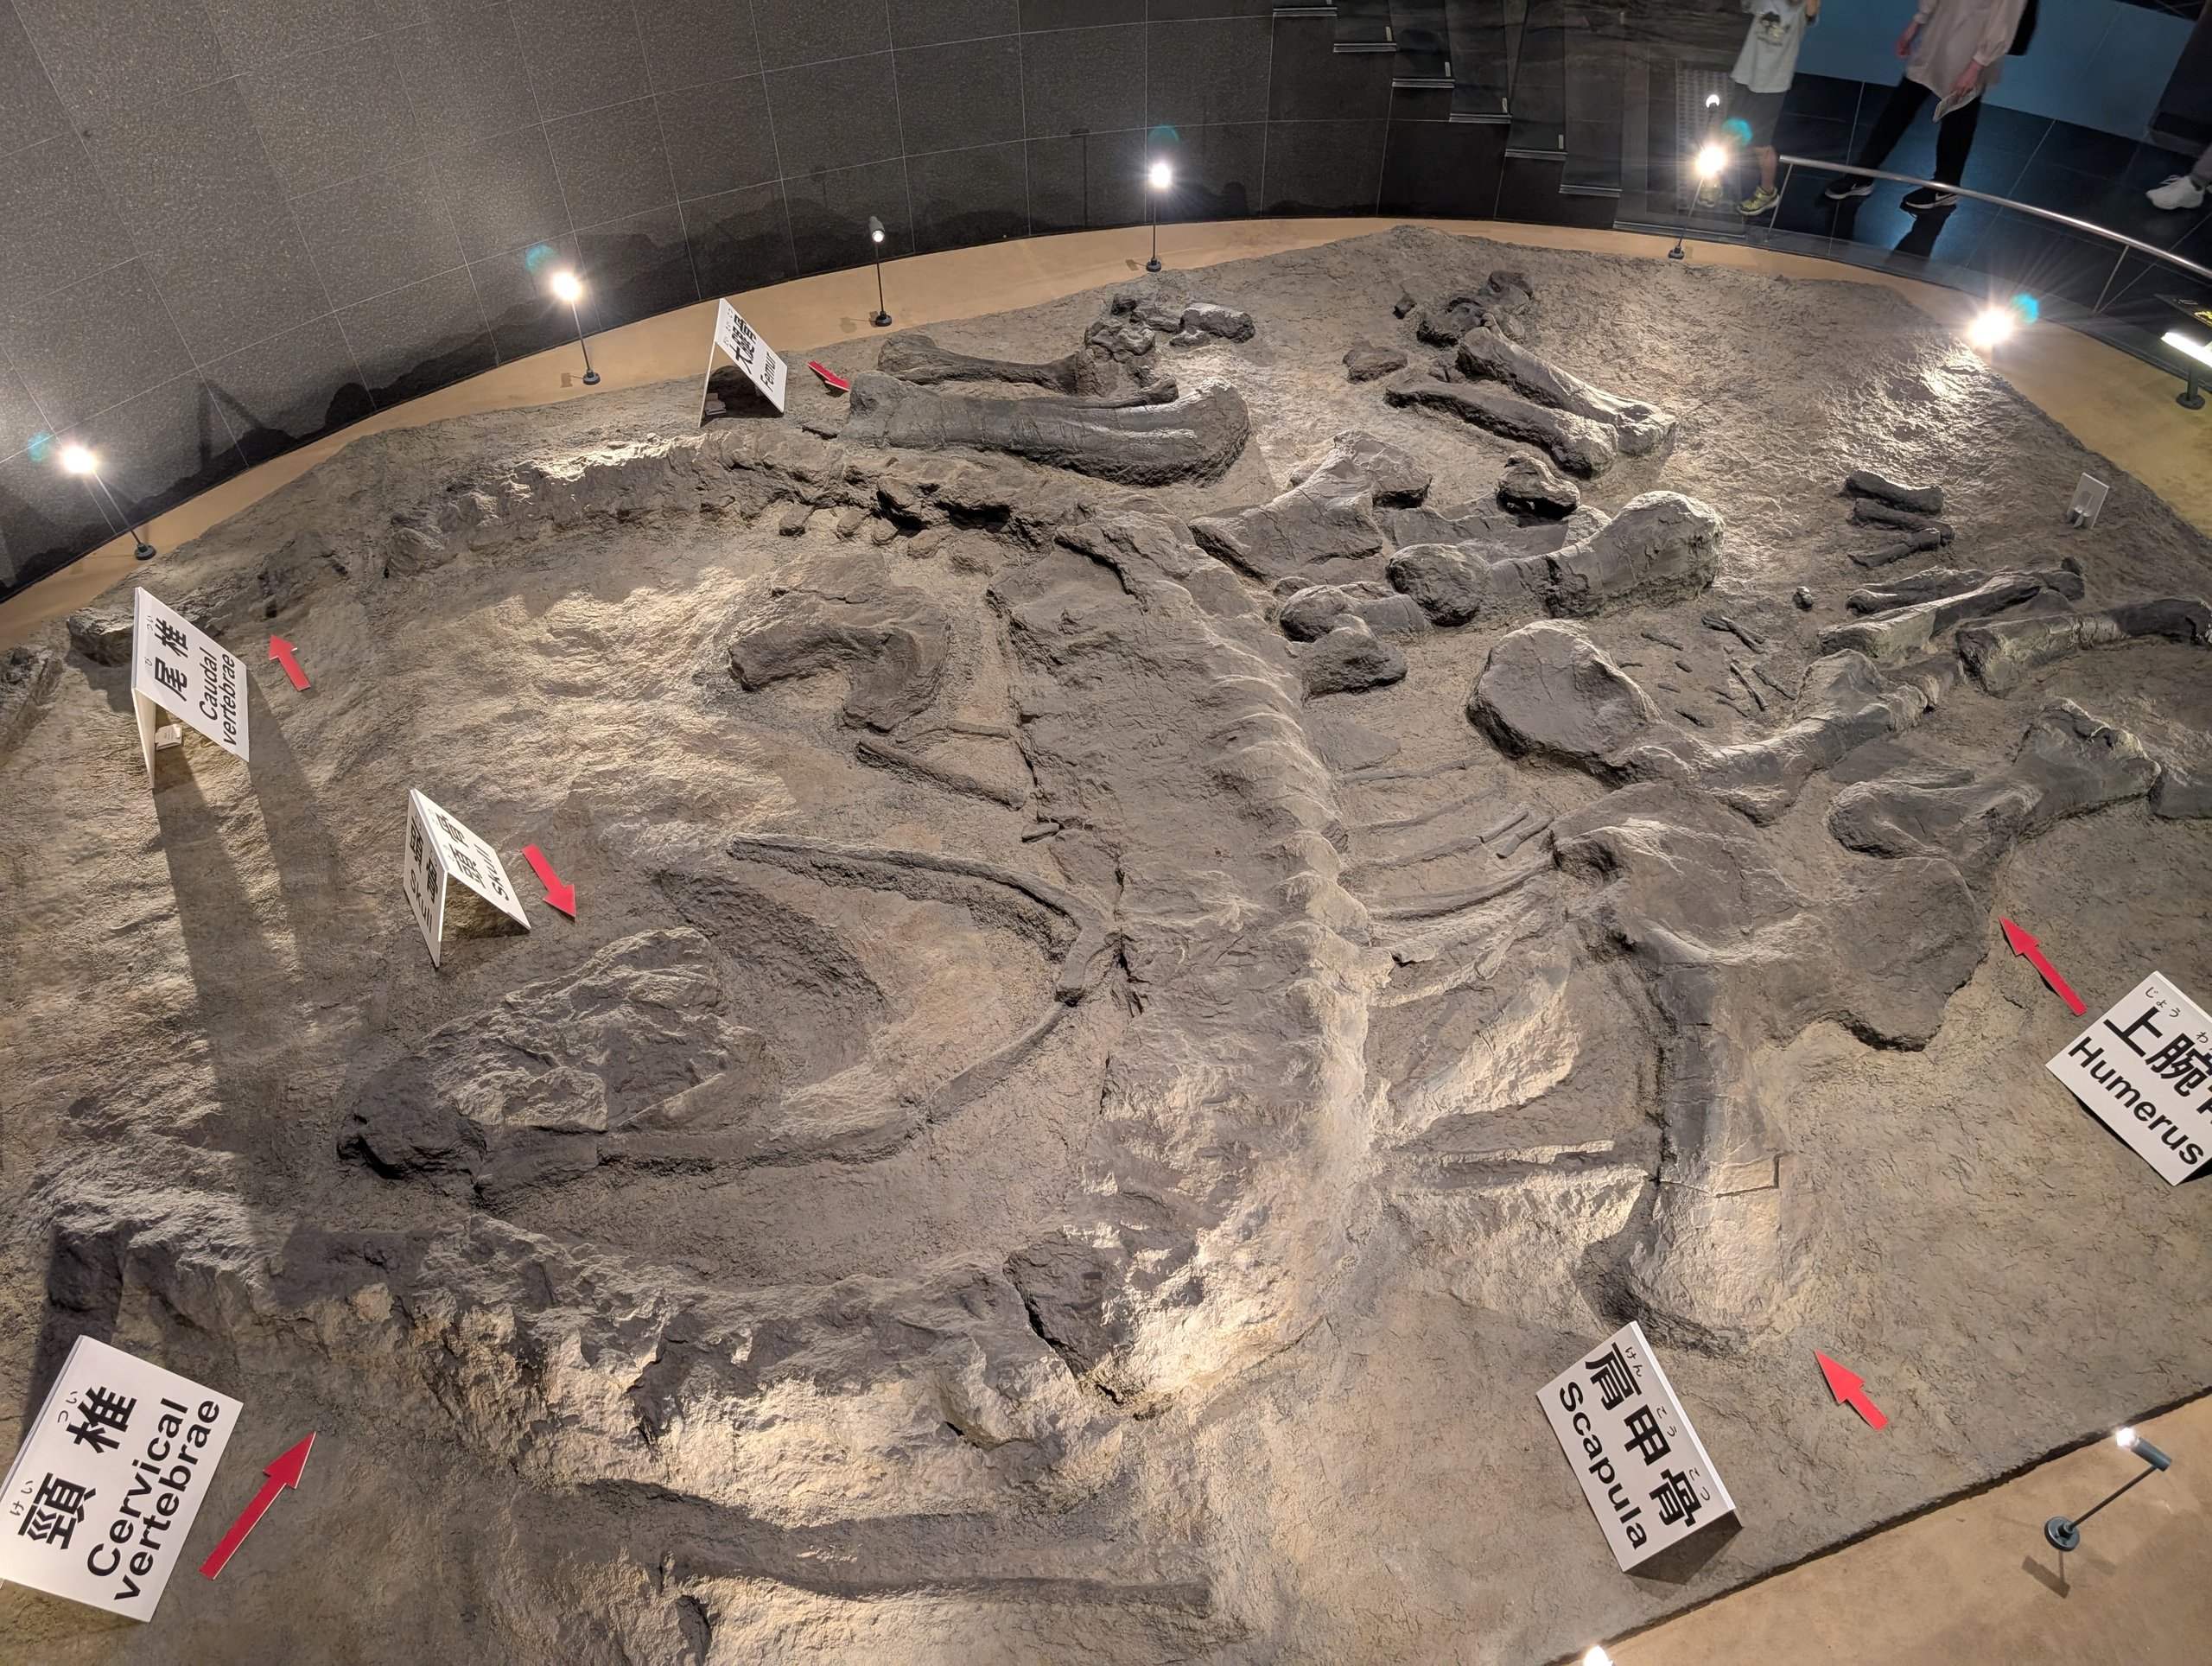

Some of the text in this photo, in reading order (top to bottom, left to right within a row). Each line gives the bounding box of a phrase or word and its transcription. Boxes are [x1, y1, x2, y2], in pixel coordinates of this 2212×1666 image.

[729, 314, 757, 375] 大腿骨
[760, 351, 776, 392] Femur
[200, 646, 218, 721] Caudal
[222, 653, 237, 746] vertebrae
[410, 868, 432, 933] Skull
[474, 843, 509, 901] Skull
[2145, 987, 2181, 1018] じょう
[2068, 1036, 2203, 1165] Humerus
[2103, 1006, 2212, 1125] 上腕
[10, 1391, 78, 1517] けい つい
[1560, 1382, 1647, 1550] Scapula
[1585, 1342, 1701, 1528] 肩甲骨
[1624, 1347, 1711, 1502] けん こう こつ
[86, 1397, 188, 1577] Cervical
[114, 1400, 219, 1600] vertebrae
